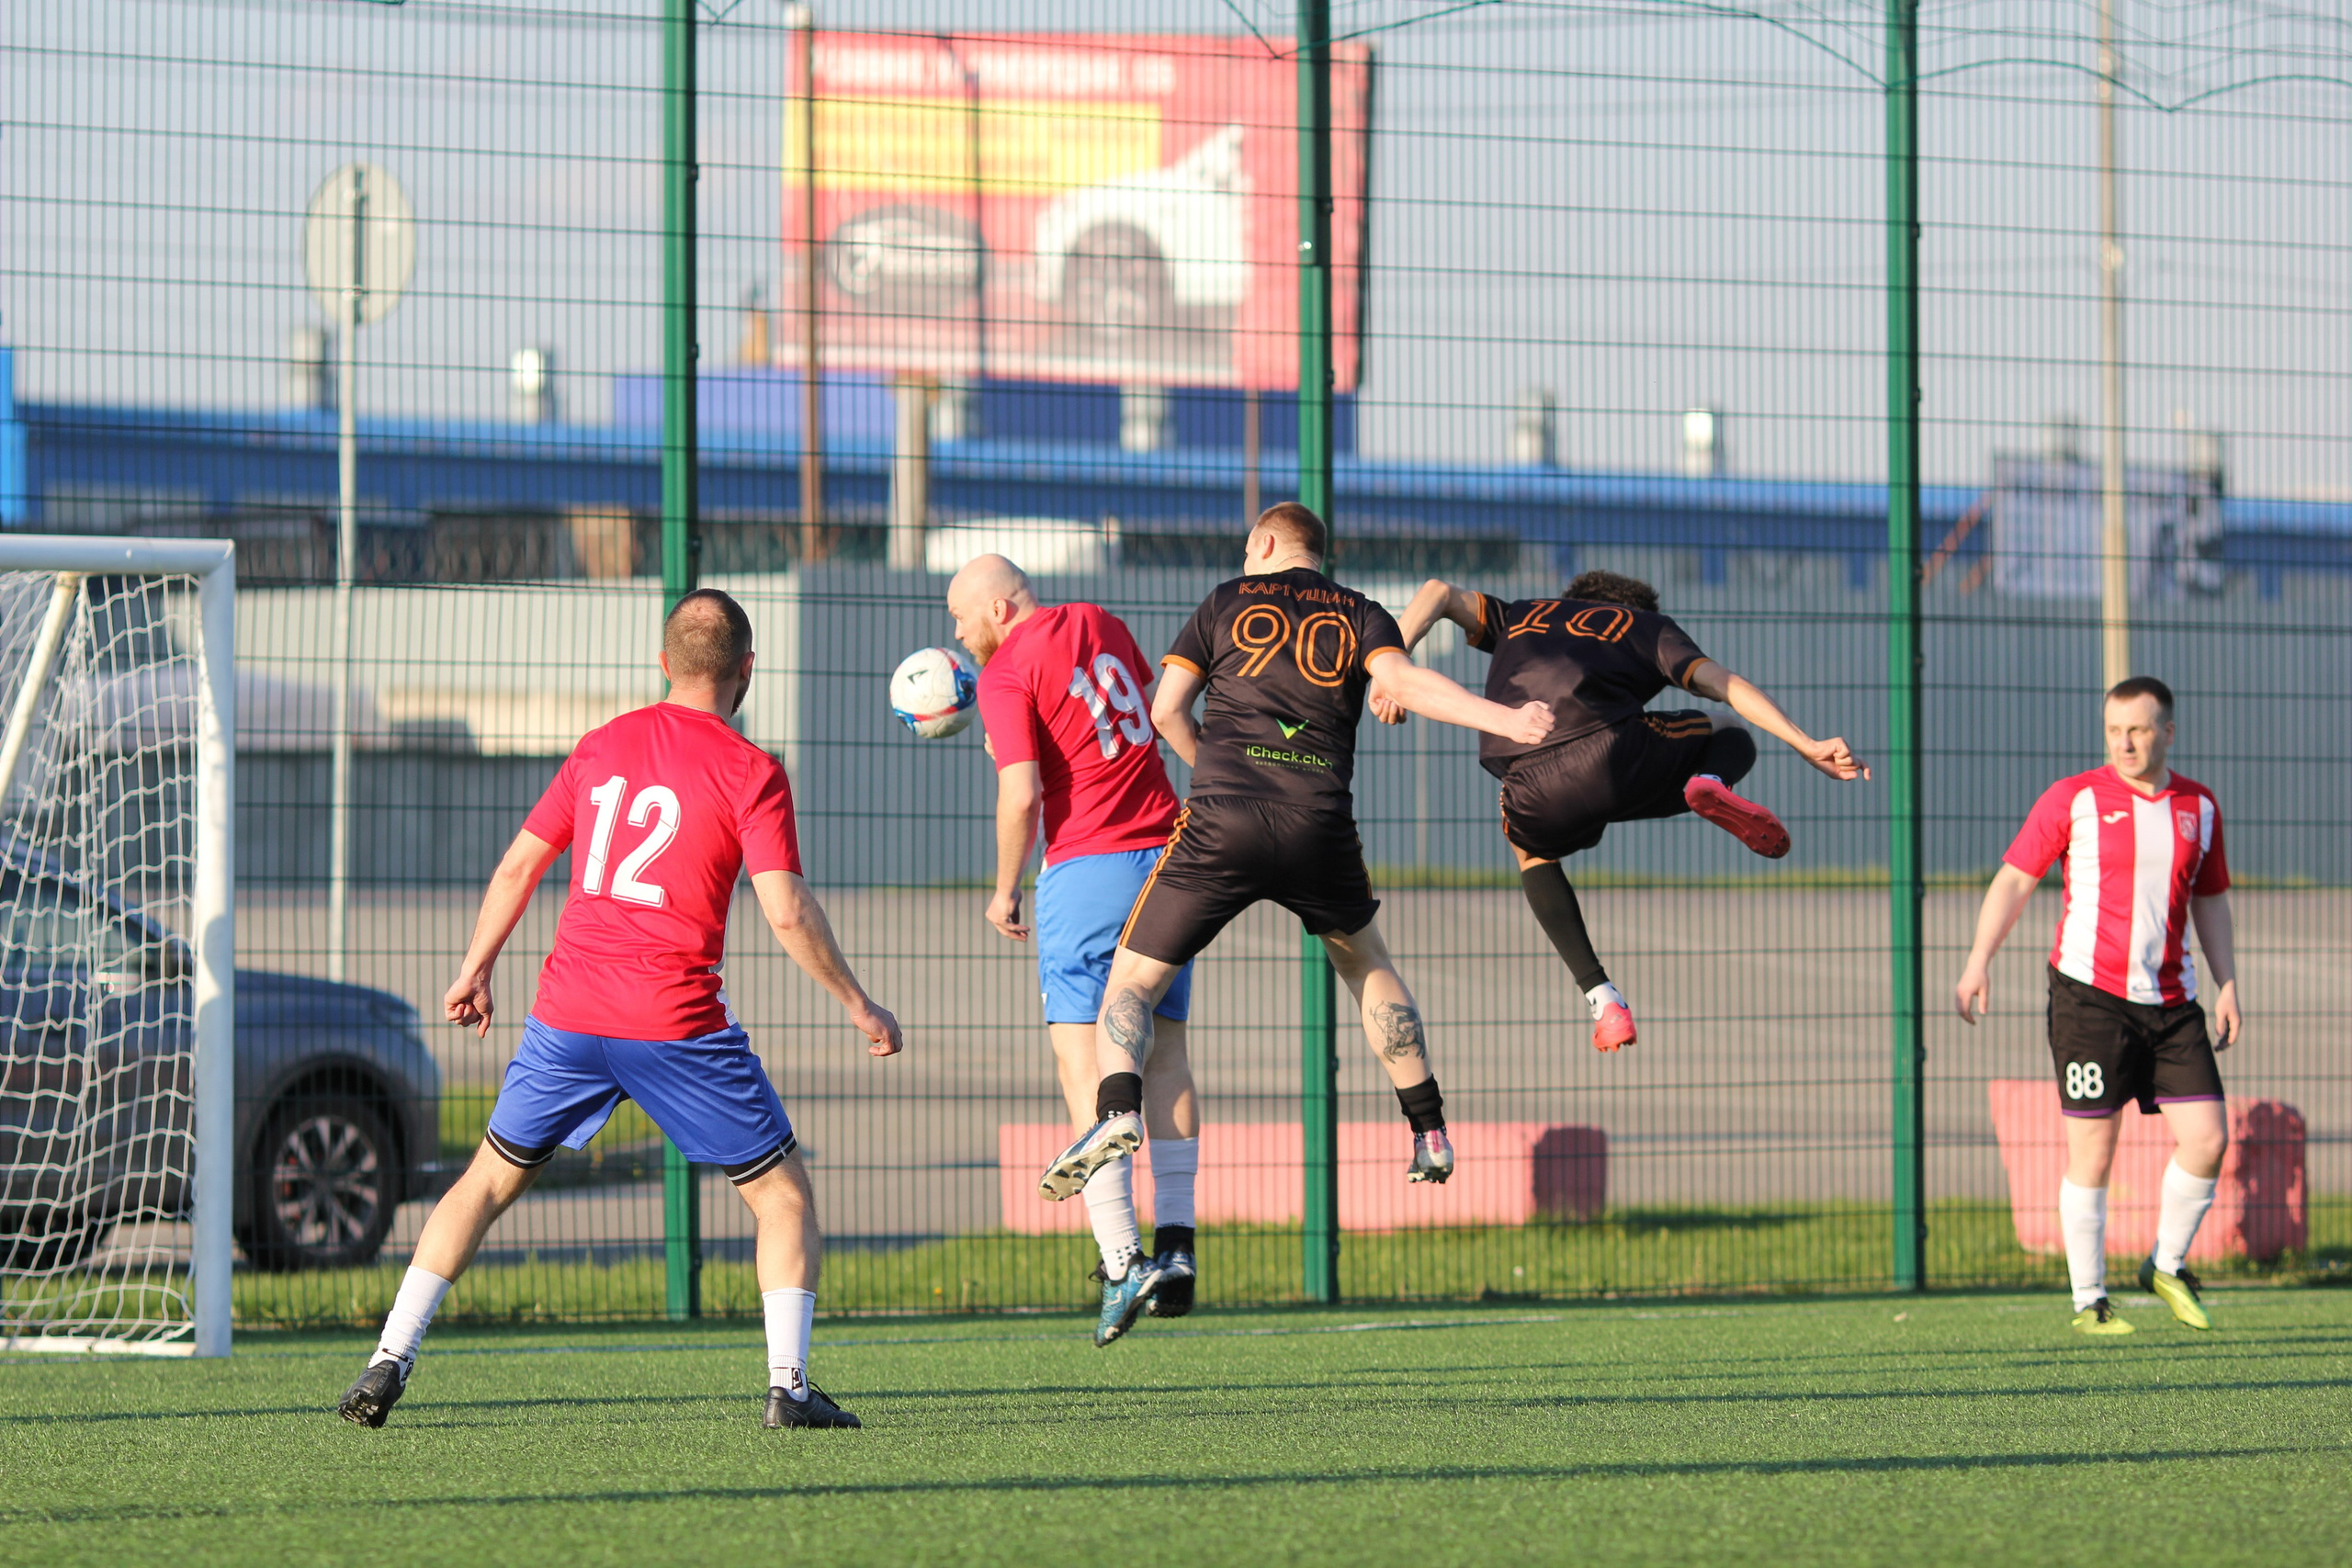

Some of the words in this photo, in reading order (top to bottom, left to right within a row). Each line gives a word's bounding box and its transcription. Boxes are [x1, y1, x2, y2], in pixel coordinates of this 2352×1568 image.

[1231, 604, 1357, 687] 90
[1069, 653, 1153, 760] 19
[582, 775, 681, 908] 12
[2066, 1062, 2105, 1100] 88
